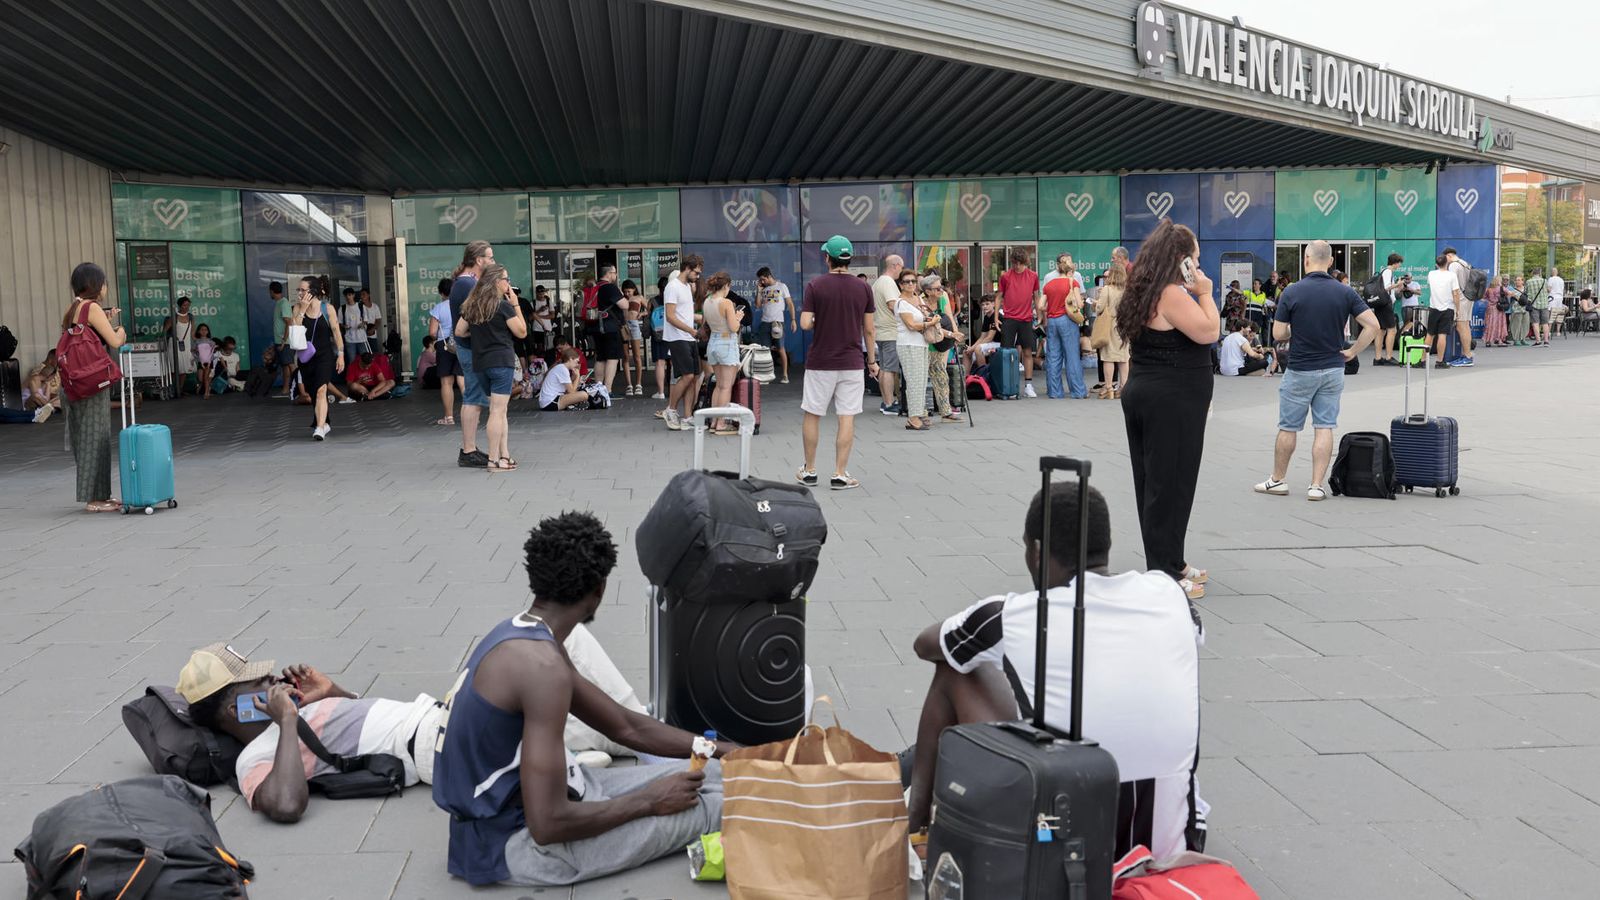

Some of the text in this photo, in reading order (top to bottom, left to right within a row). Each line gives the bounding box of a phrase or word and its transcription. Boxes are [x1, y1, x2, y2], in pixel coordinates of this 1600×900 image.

[1176, 13, 1306, 101] VALÈNCIA
[1405, 79, 1477, 141] SOROLLA
[1098, 262, 1111, 270] un
[197, 284, 222, 298] has
[134, 303, 218, 317] encoado
[135, 321, 164, 335] tod
